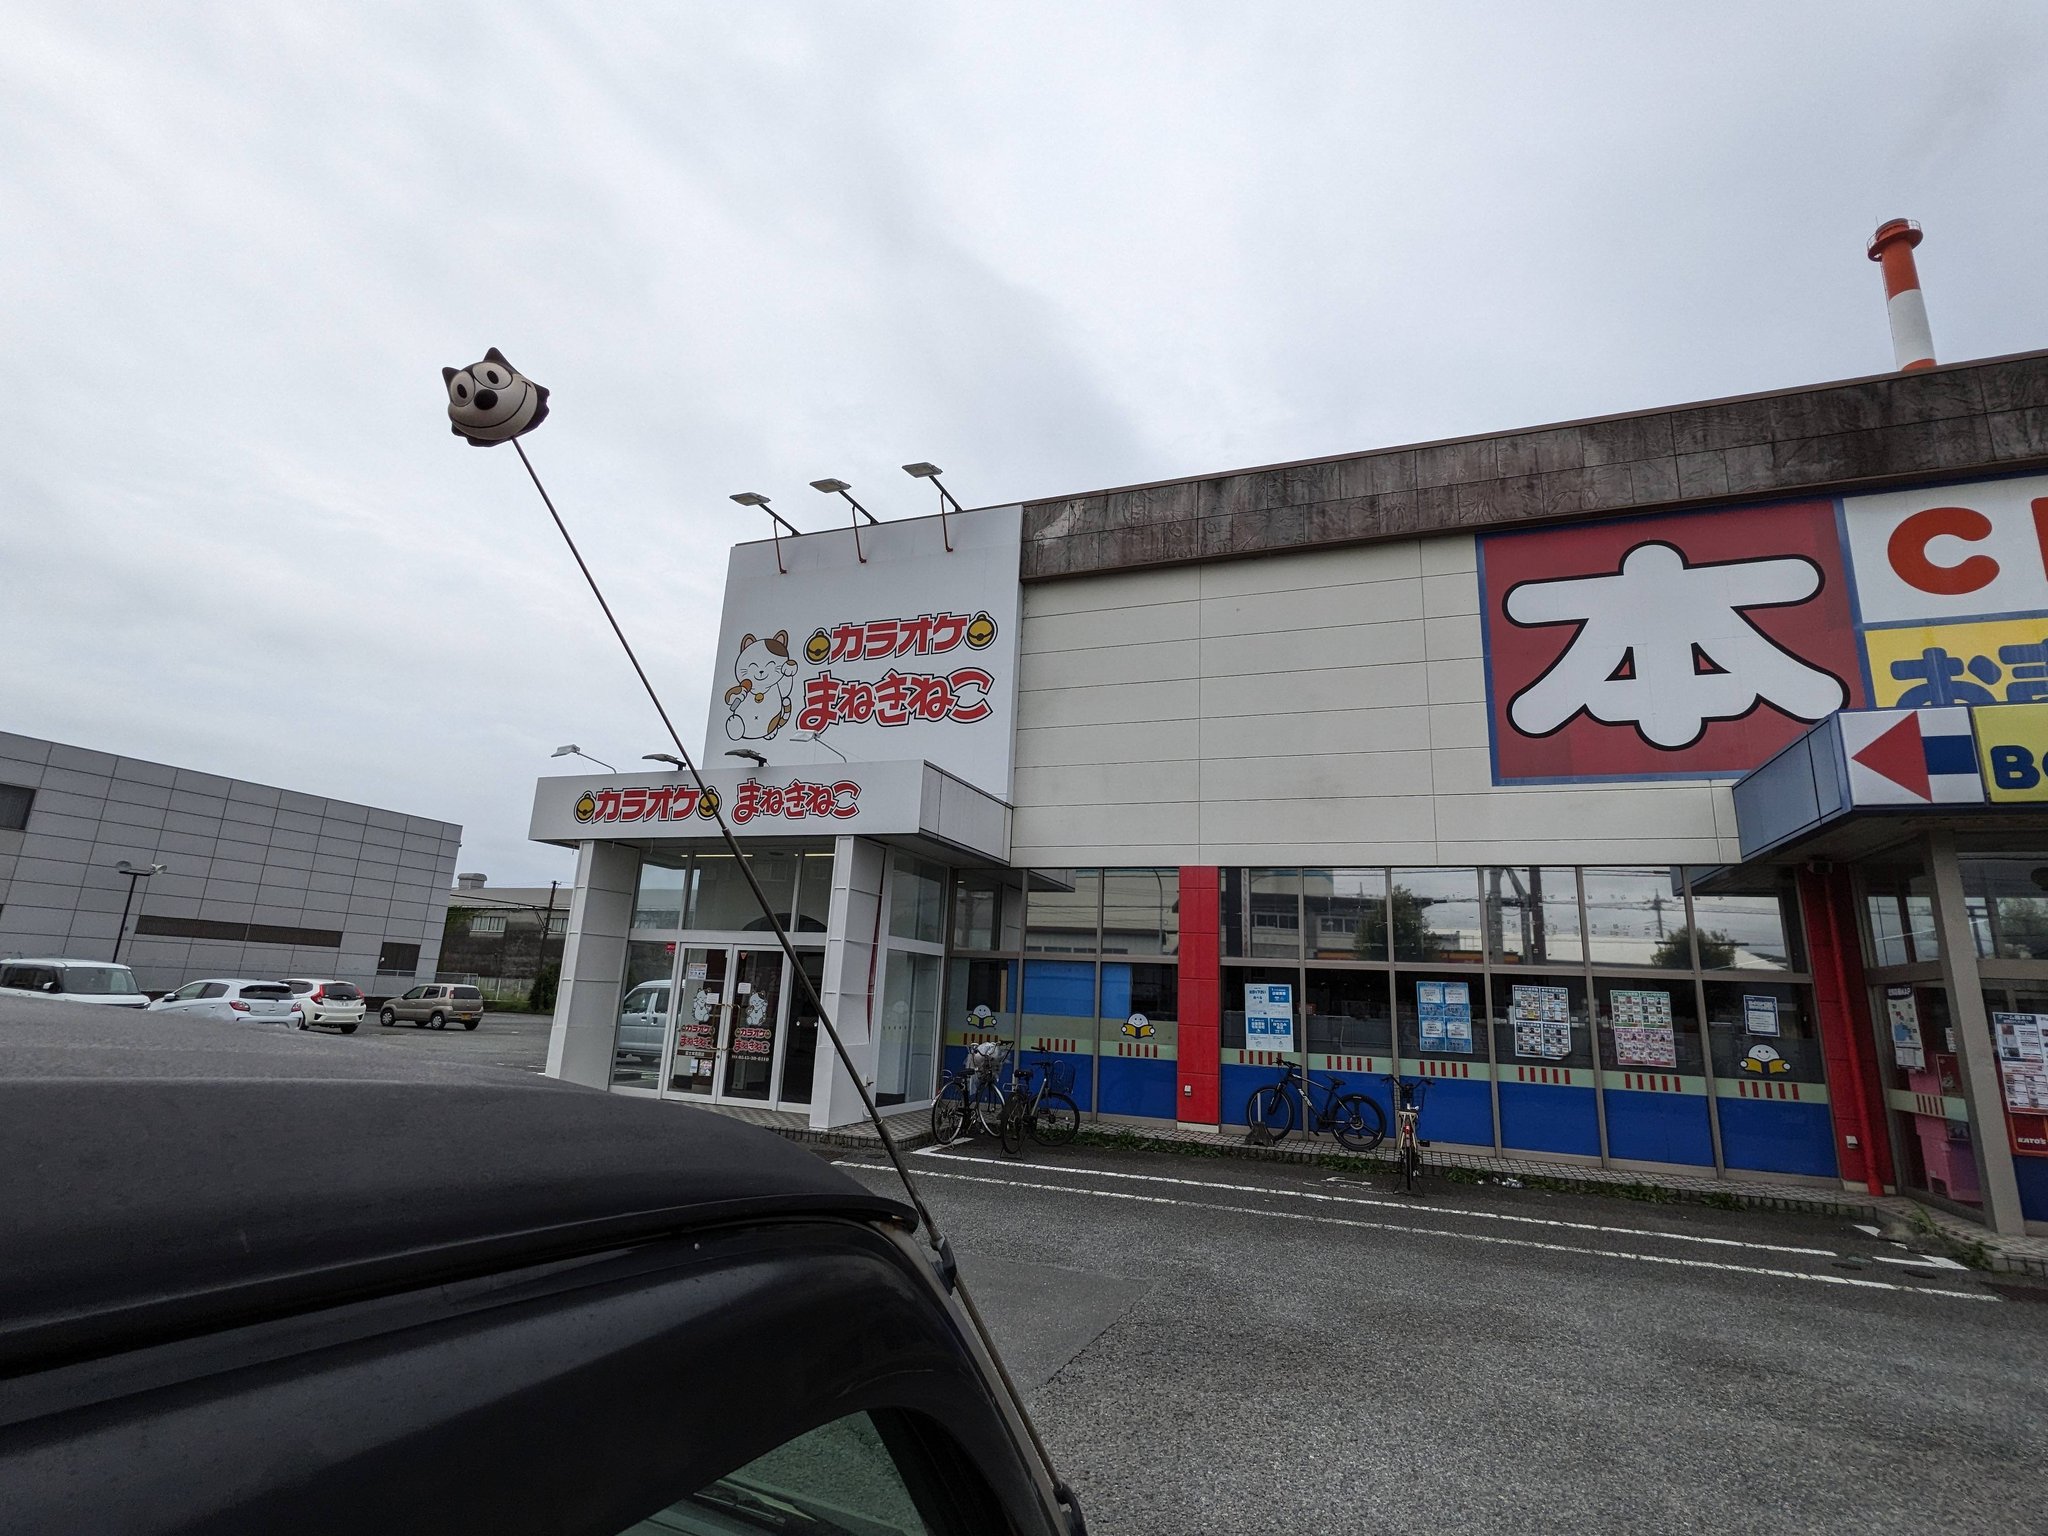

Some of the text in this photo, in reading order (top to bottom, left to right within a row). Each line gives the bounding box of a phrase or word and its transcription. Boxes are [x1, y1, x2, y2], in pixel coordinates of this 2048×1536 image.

[1887, 497, 2048, 595] C
[829, 612, 970, 665] カラオケ
[1502, 540, 1850, 750] 本
[796, 668, 995, 732] まねきねこ
[1990, 744, 2048, 790] B
[592, 778, 862, 825] カラオケ まねきねこ
[685, 1024, 711, 1034] カラオケ
[733, 1039, 770, 1054] まねきねこ
[740, 1028, 766, 1038] カラオケ
